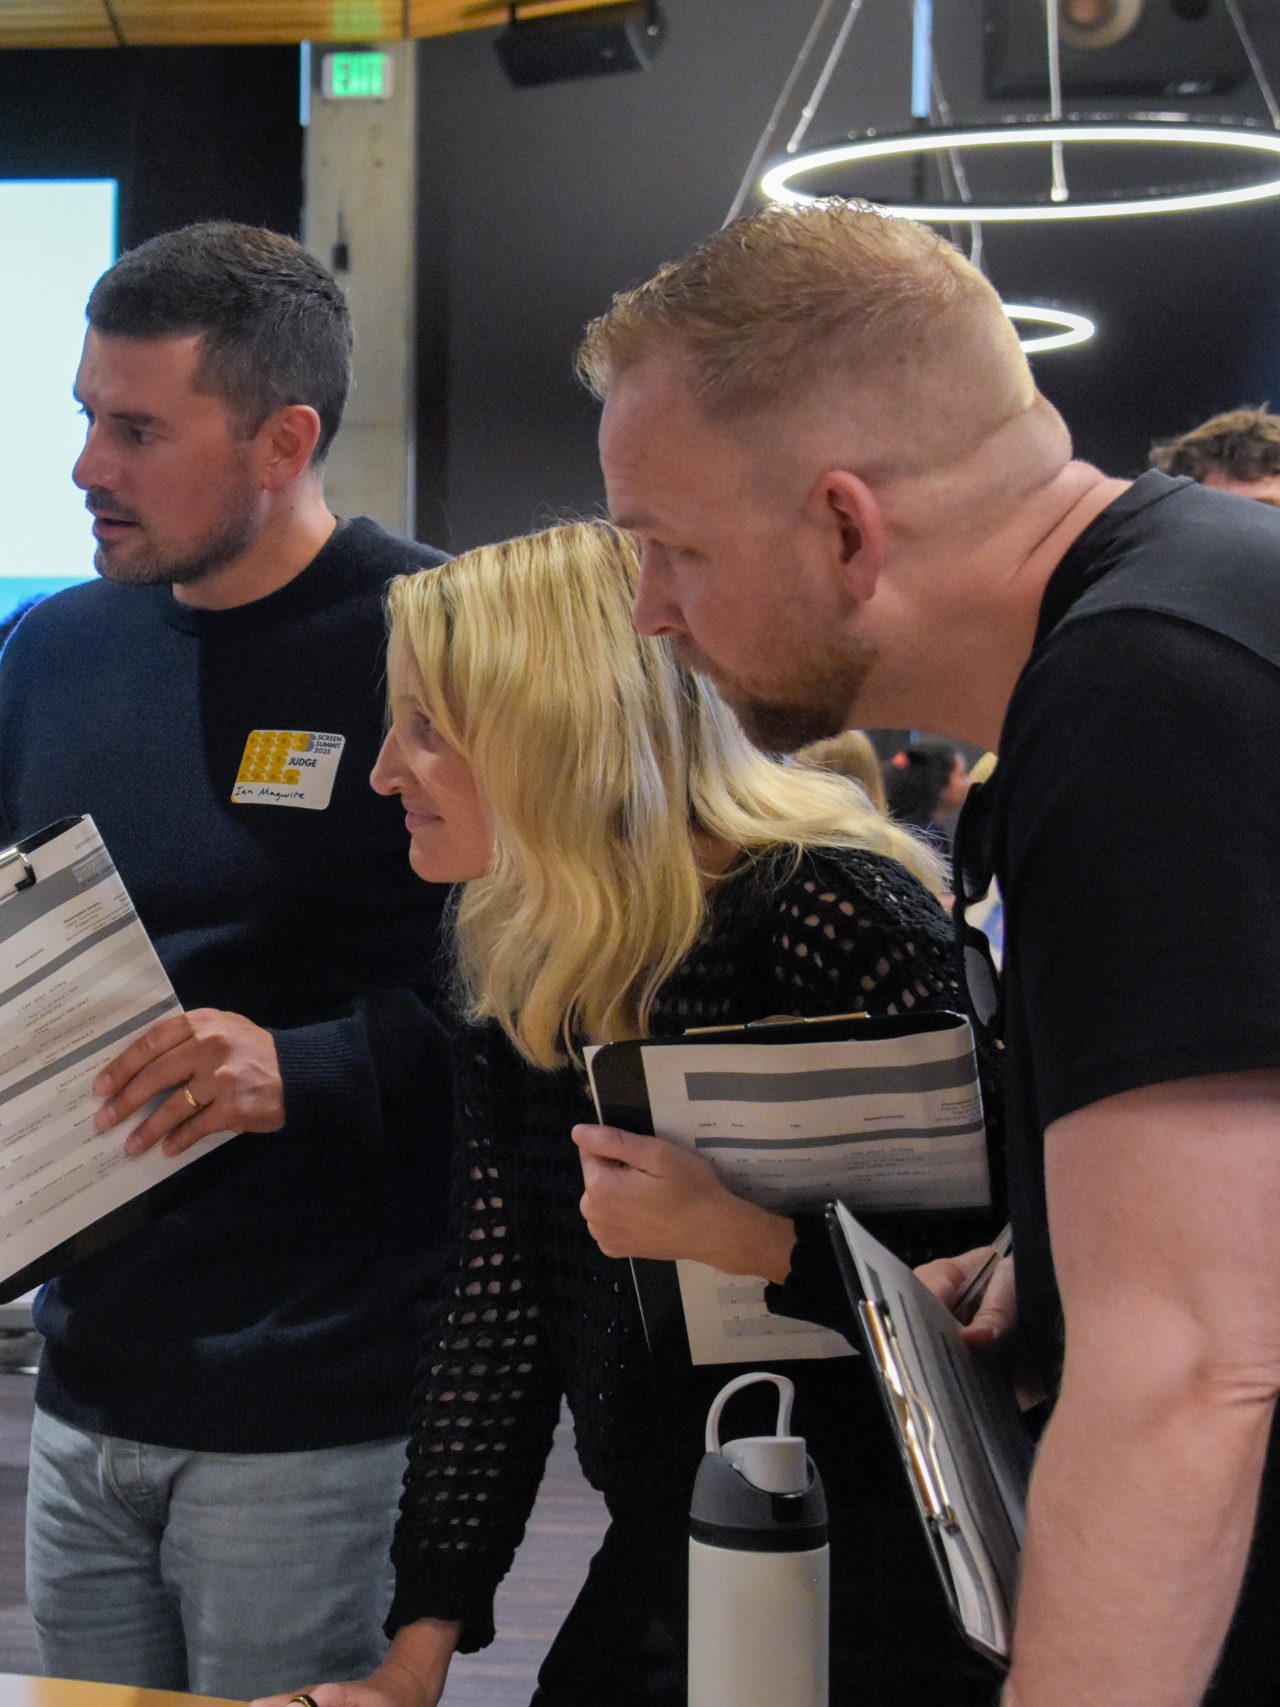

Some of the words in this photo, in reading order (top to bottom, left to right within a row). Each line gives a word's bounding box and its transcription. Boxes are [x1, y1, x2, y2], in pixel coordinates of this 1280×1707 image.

[332, 52, 384, 96] EXIT
[317, 734, 342, 742] SCREEN
[316, 741, 341, 749] SUMMIT
[288, 757, 318, 768] JUDGE
